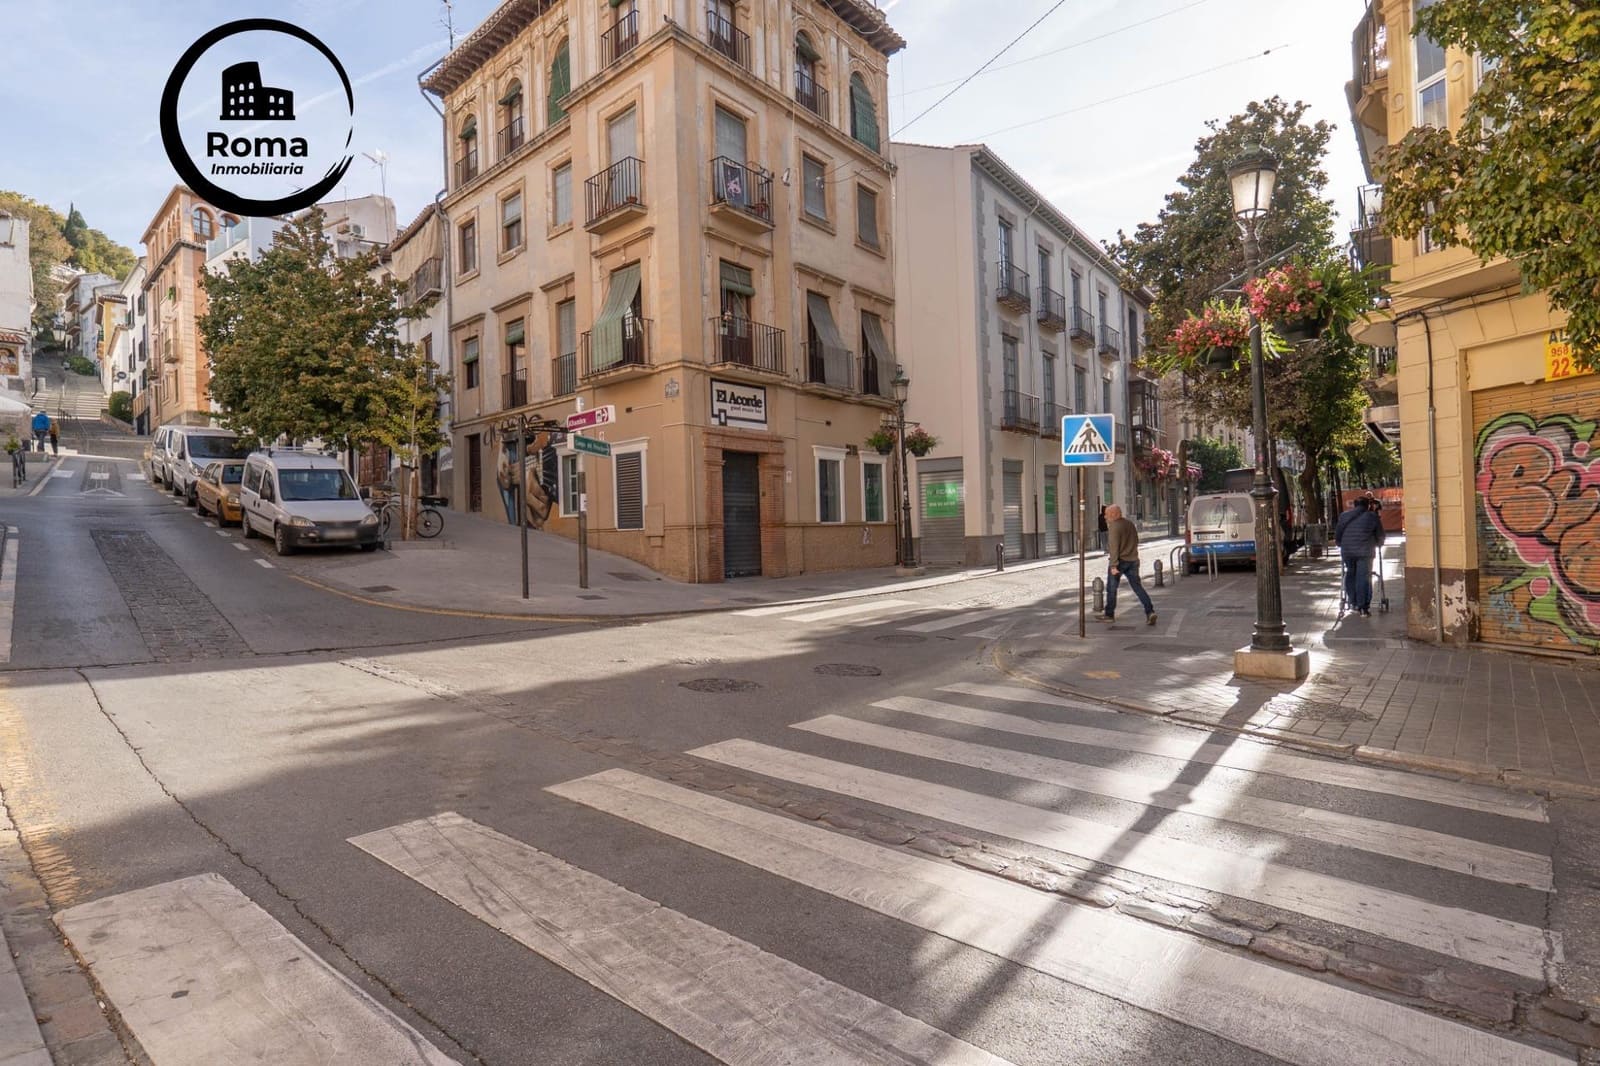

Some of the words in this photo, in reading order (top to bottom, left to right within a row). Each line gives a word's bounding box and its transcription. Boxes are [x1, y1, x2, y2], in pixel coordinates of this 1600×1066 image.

[1551, 357, 1570, 378] 22
[716, 389, 727, 403] El
[728, 391, 763, 408] Acorde
